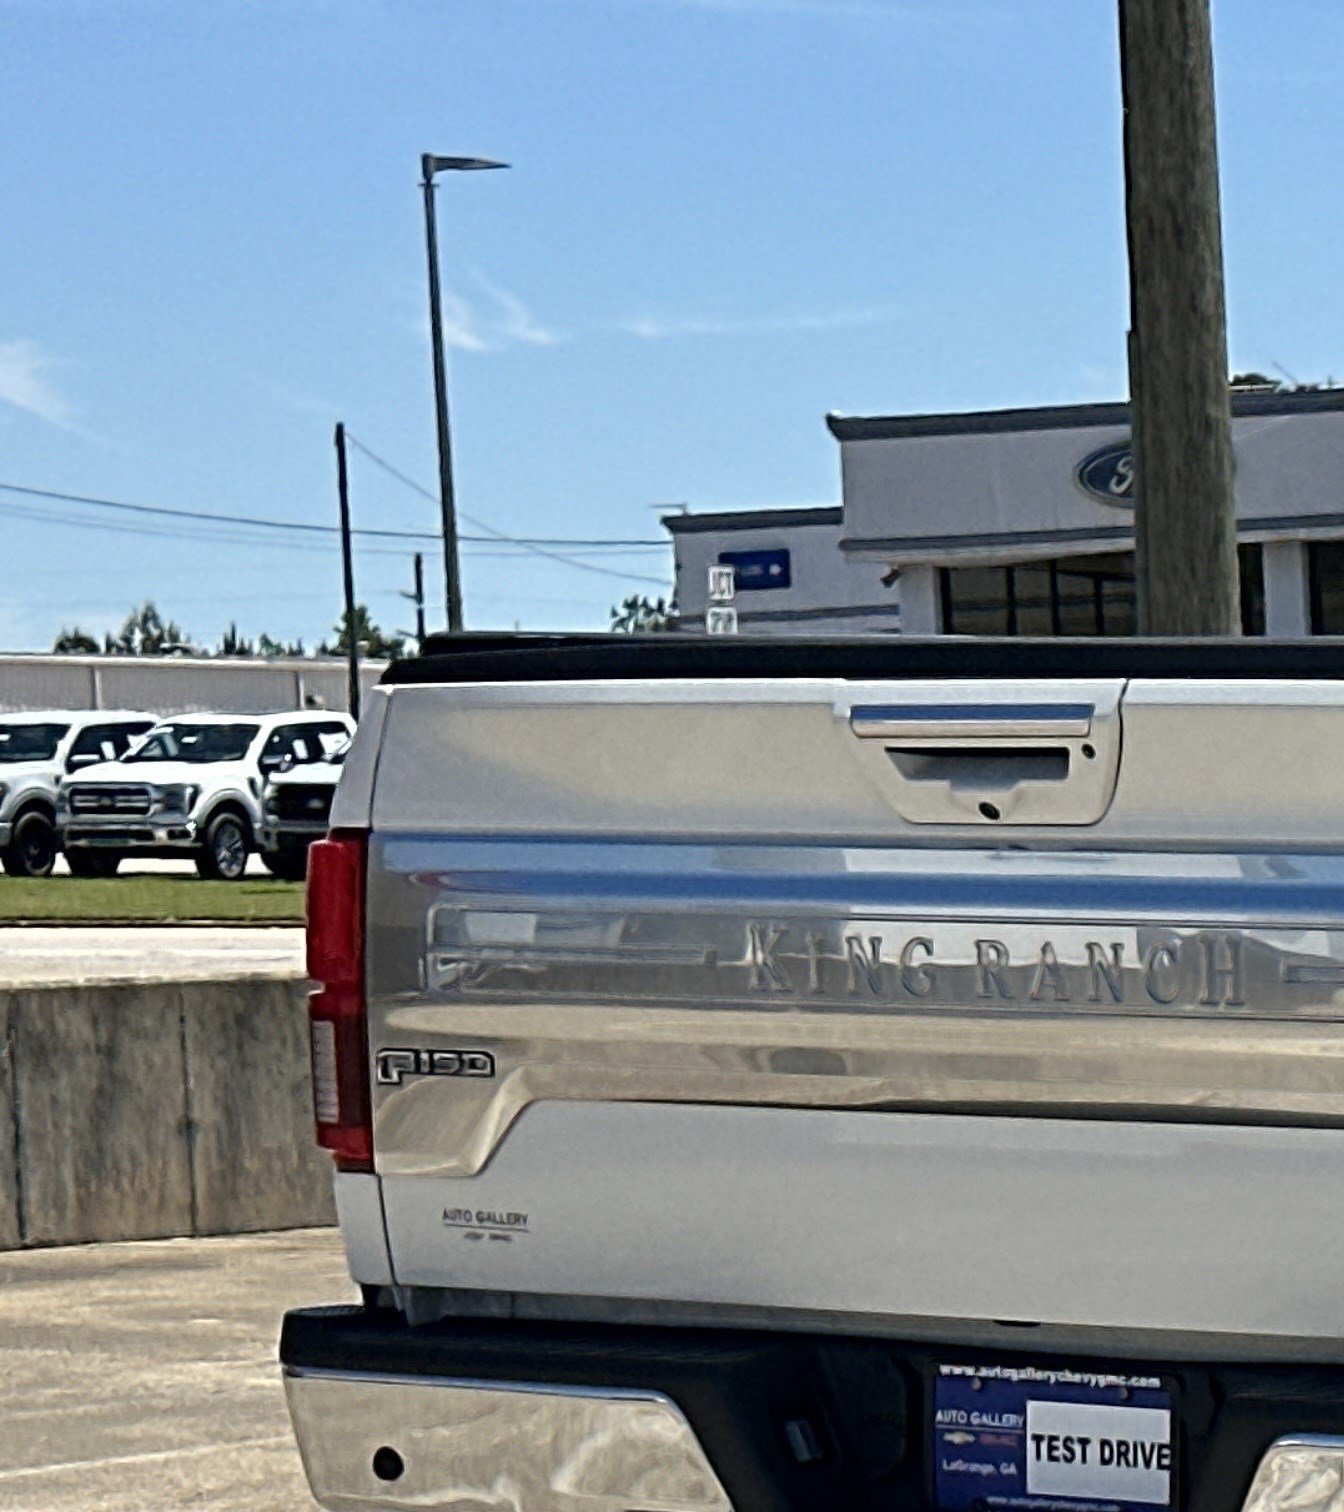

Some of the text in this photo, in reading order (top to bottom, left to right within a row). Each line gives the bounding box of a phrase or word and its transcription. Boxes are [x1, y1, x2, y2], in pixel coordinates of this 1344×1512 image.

[748, 921, 1247, 1008] KING RANCH
[442, 1207, 530, 1227] AUTO GALLERY
[935, 1409, 1025, 1429] AUTO GALLERY
[1031, 1432, 1092, 1465] TEST
[1100, 1438, 1172, 1472] DRIVE
